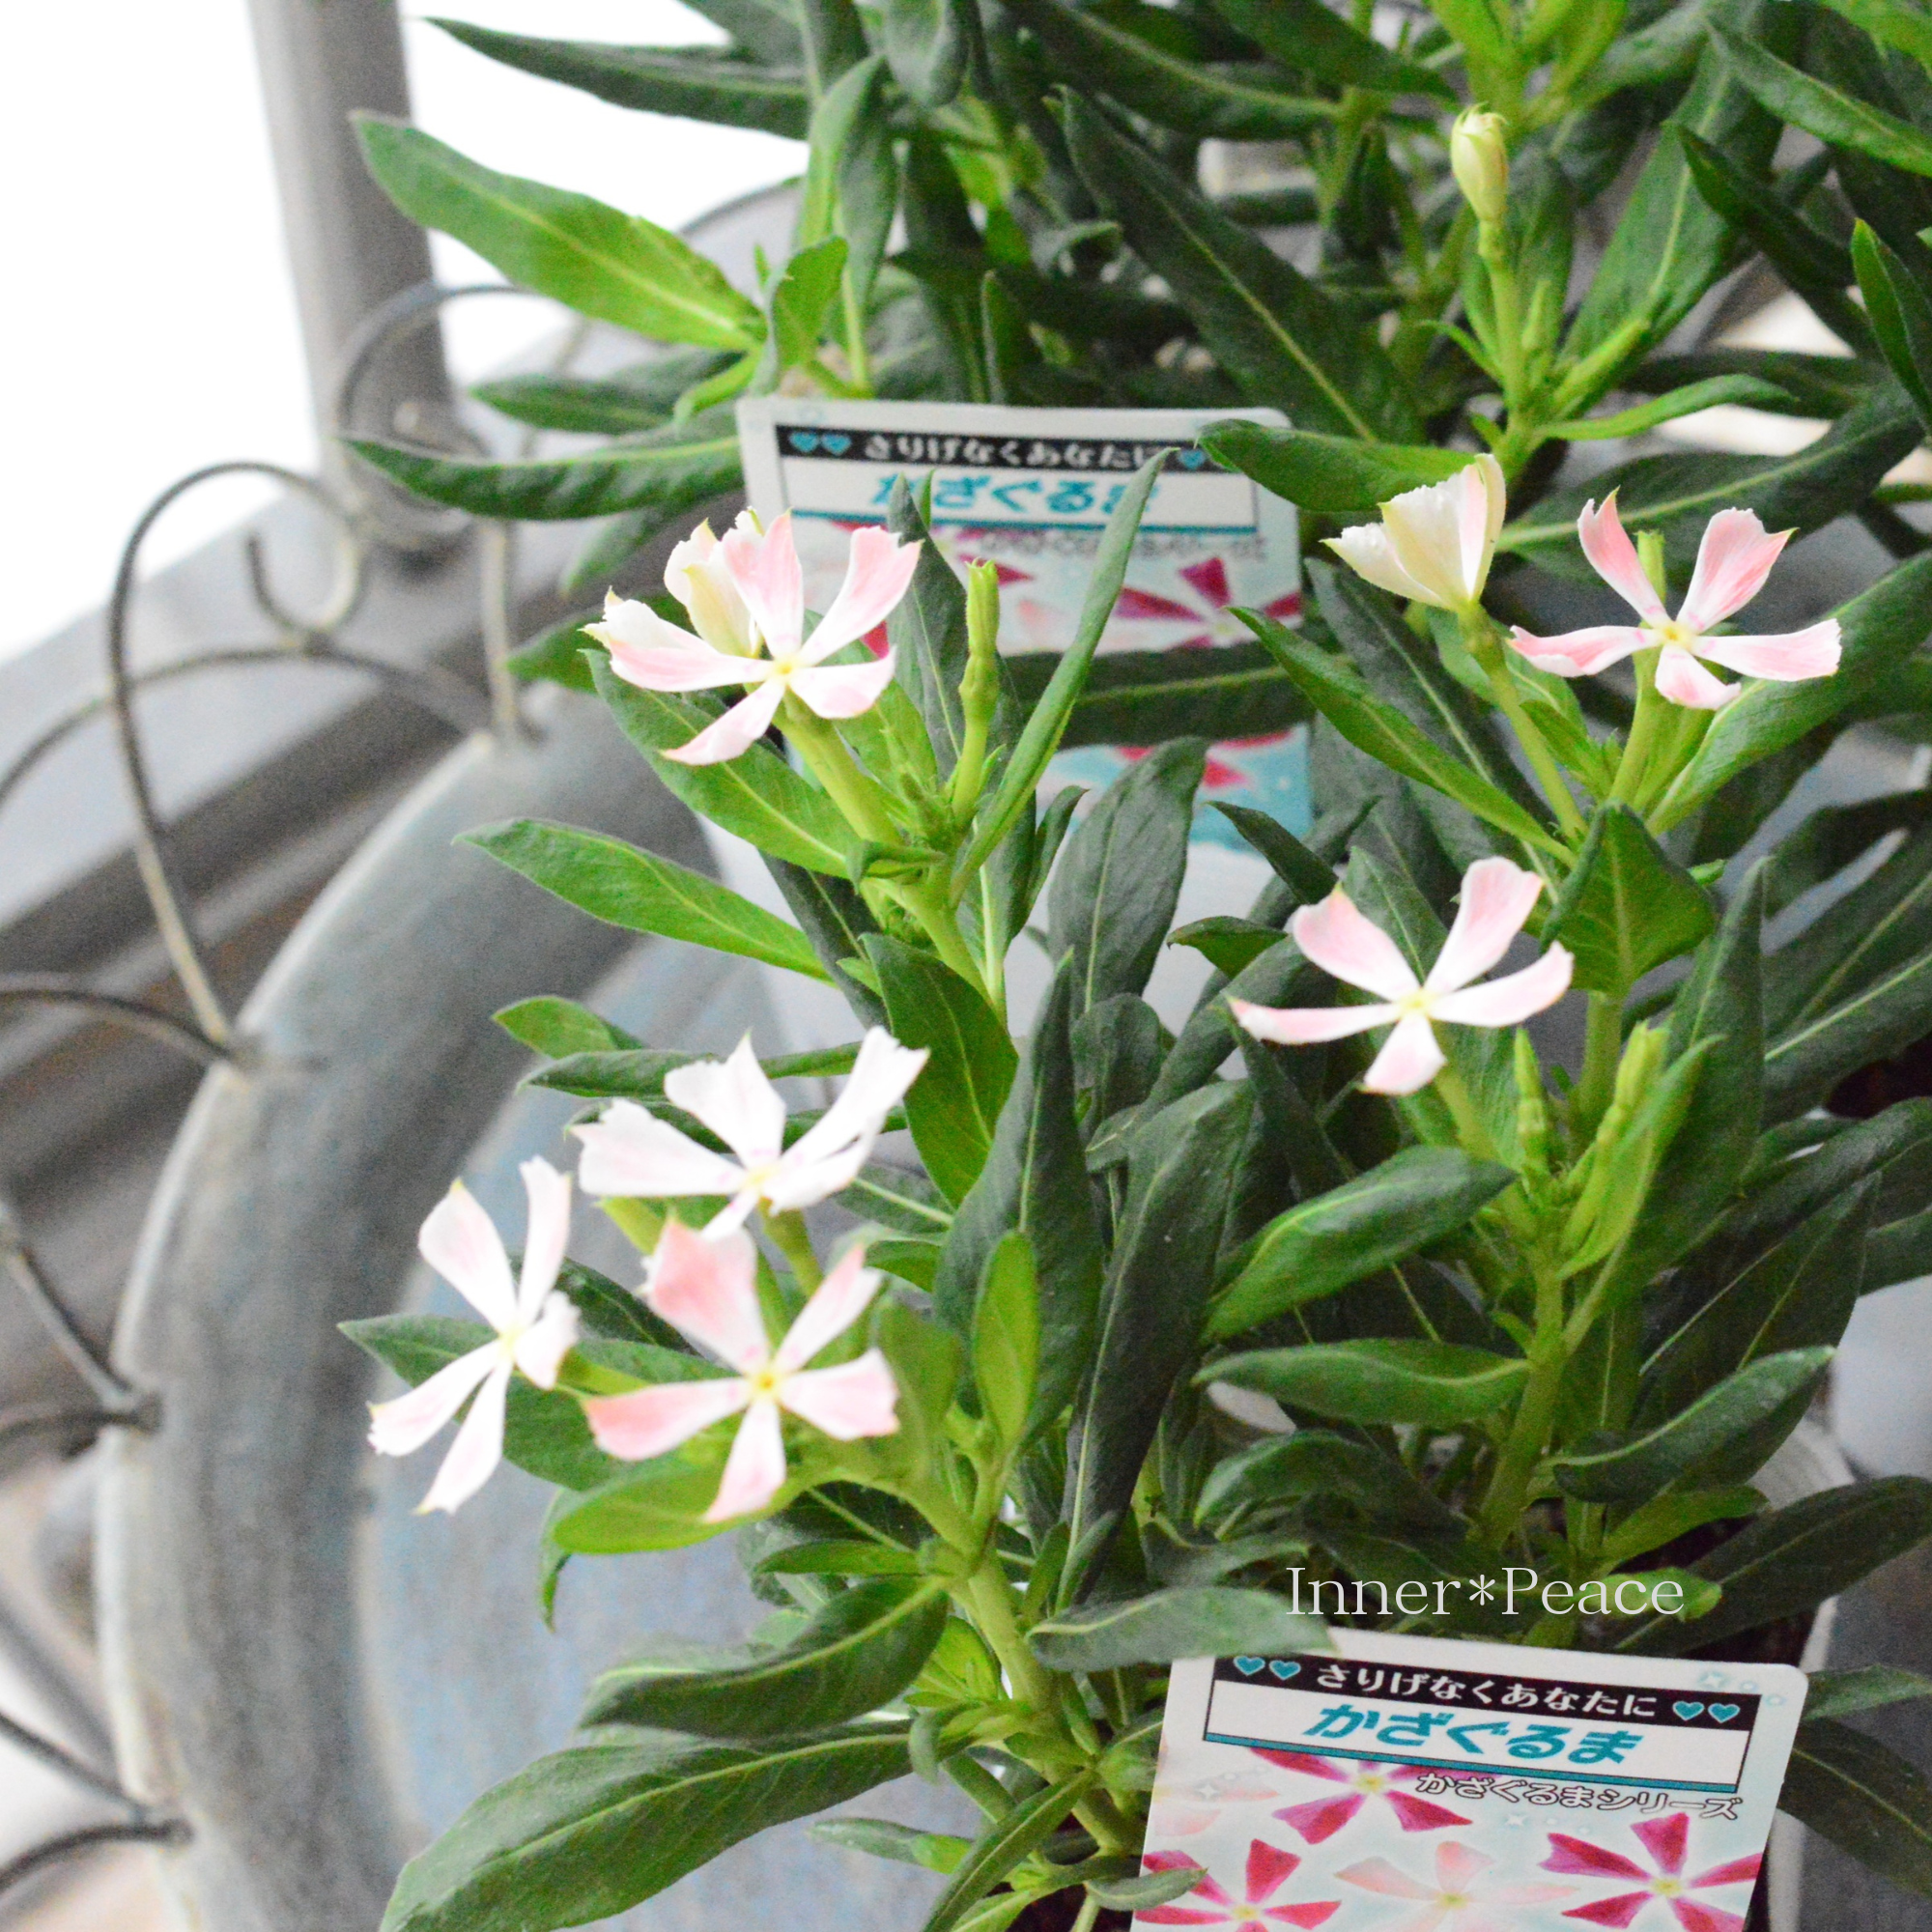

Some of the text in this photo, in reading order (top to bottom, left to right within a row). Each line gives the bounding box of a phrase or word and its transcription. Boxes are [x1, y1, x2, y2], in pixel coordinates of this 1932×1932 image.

[1317, 1664, 1657, 1718] さりげなくあなたに
[1304, 1703, 1644, 1764] かざぐるま
[1416, 1773, 1742, 1820] かざぐるまシリーズ
